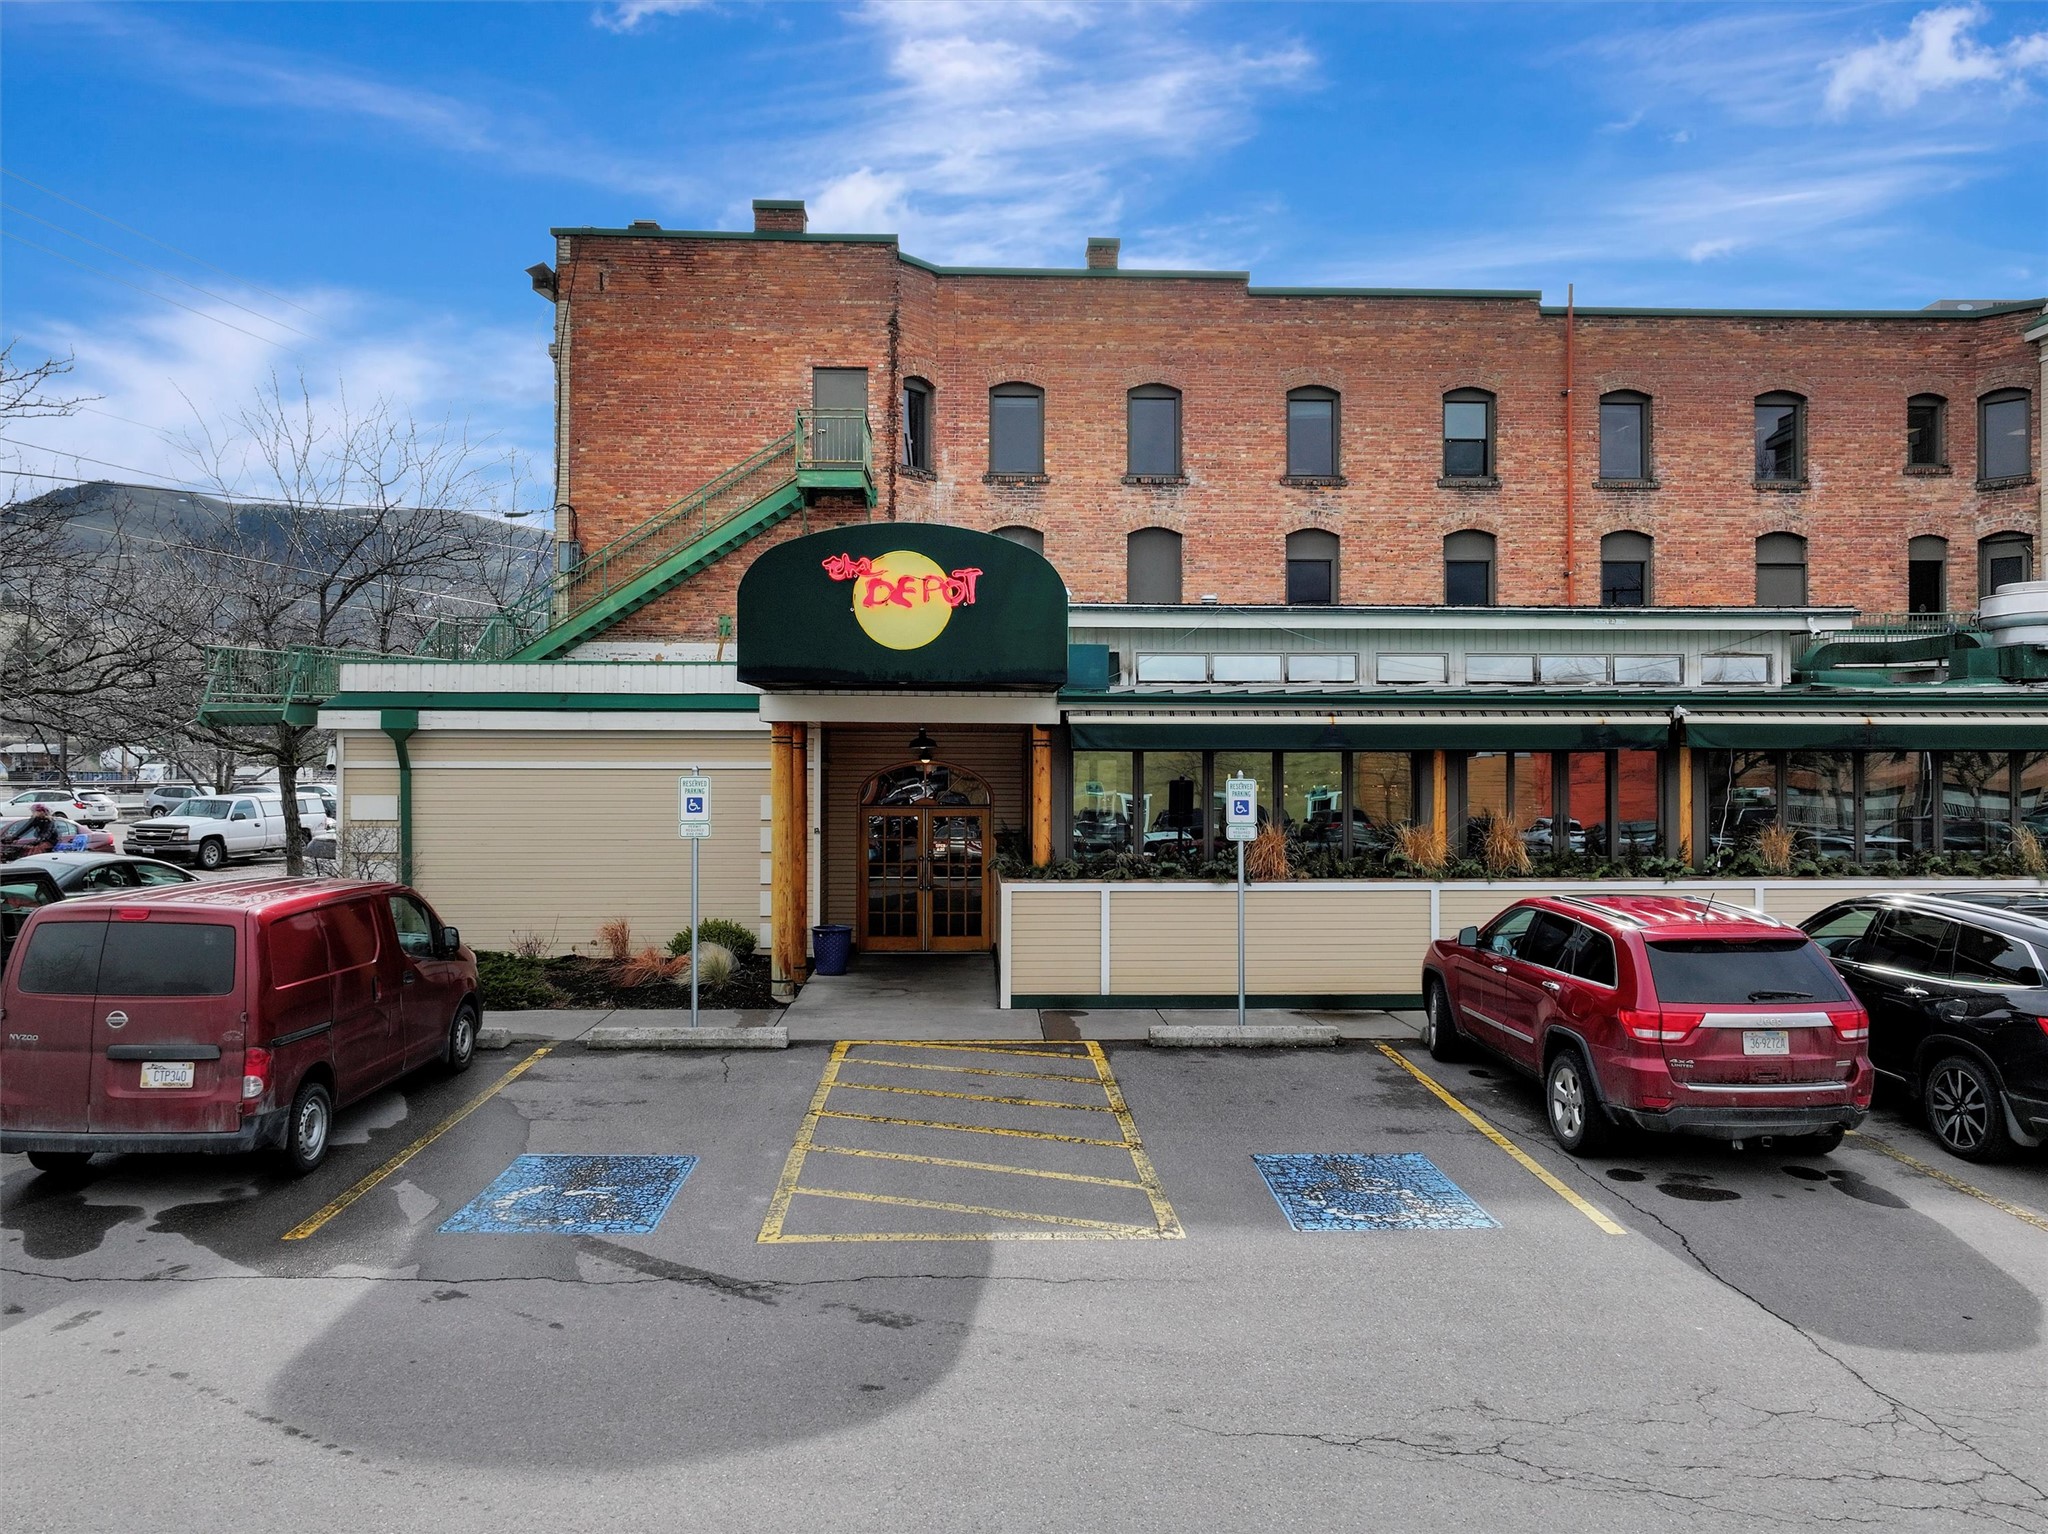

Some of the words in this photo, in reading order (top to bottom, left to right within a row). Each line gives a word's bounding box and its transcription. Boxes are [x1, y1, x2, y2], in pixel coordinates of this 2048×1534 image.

[863, 567, 983, 608] DEPOT
[1756, 1016, 1783, 1026] Jeep
[153, 1070, 187, 1082] CTP340
